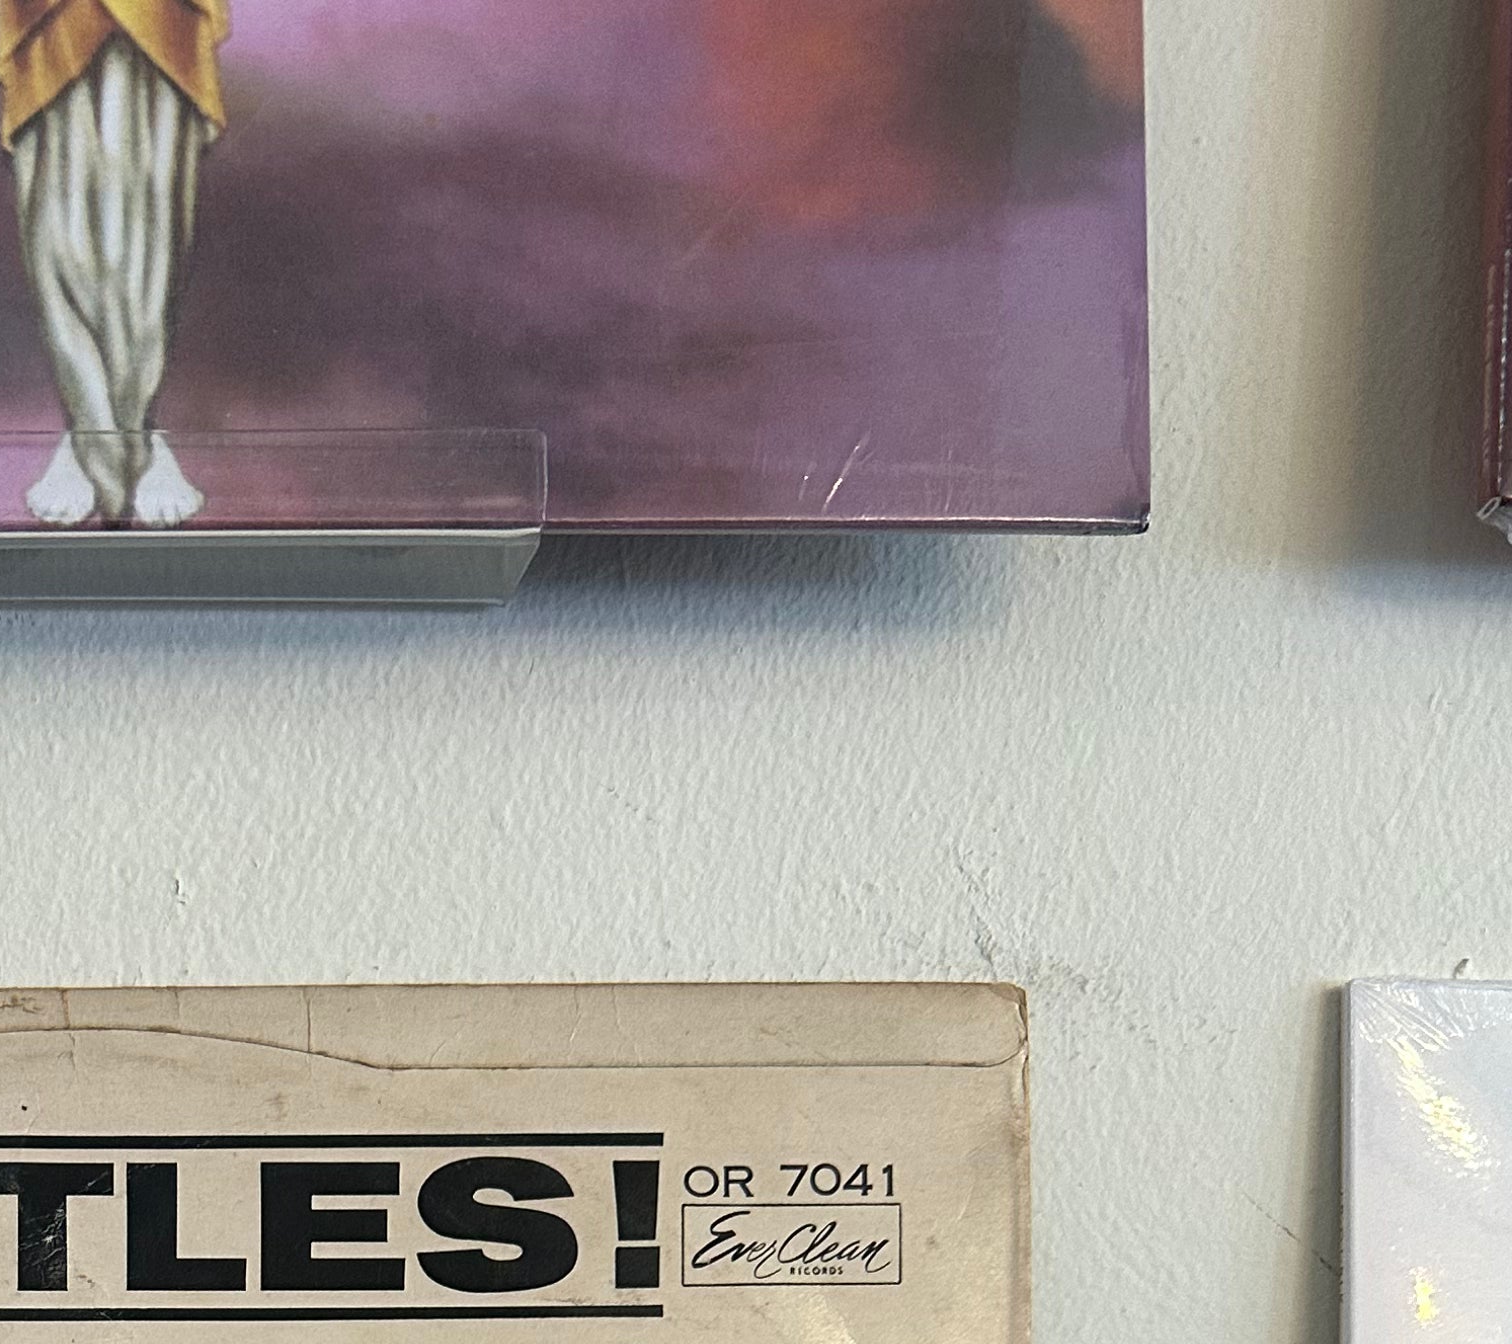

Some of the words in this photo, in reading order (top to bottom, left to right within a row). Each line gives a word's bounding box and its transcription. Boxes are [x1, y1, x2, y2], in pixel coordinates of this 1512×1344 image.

[683, 1164, 755, 1199] OR
[780, 1163, 894, 1198] 7041
[777, 1221, 892, 1273] Clean
